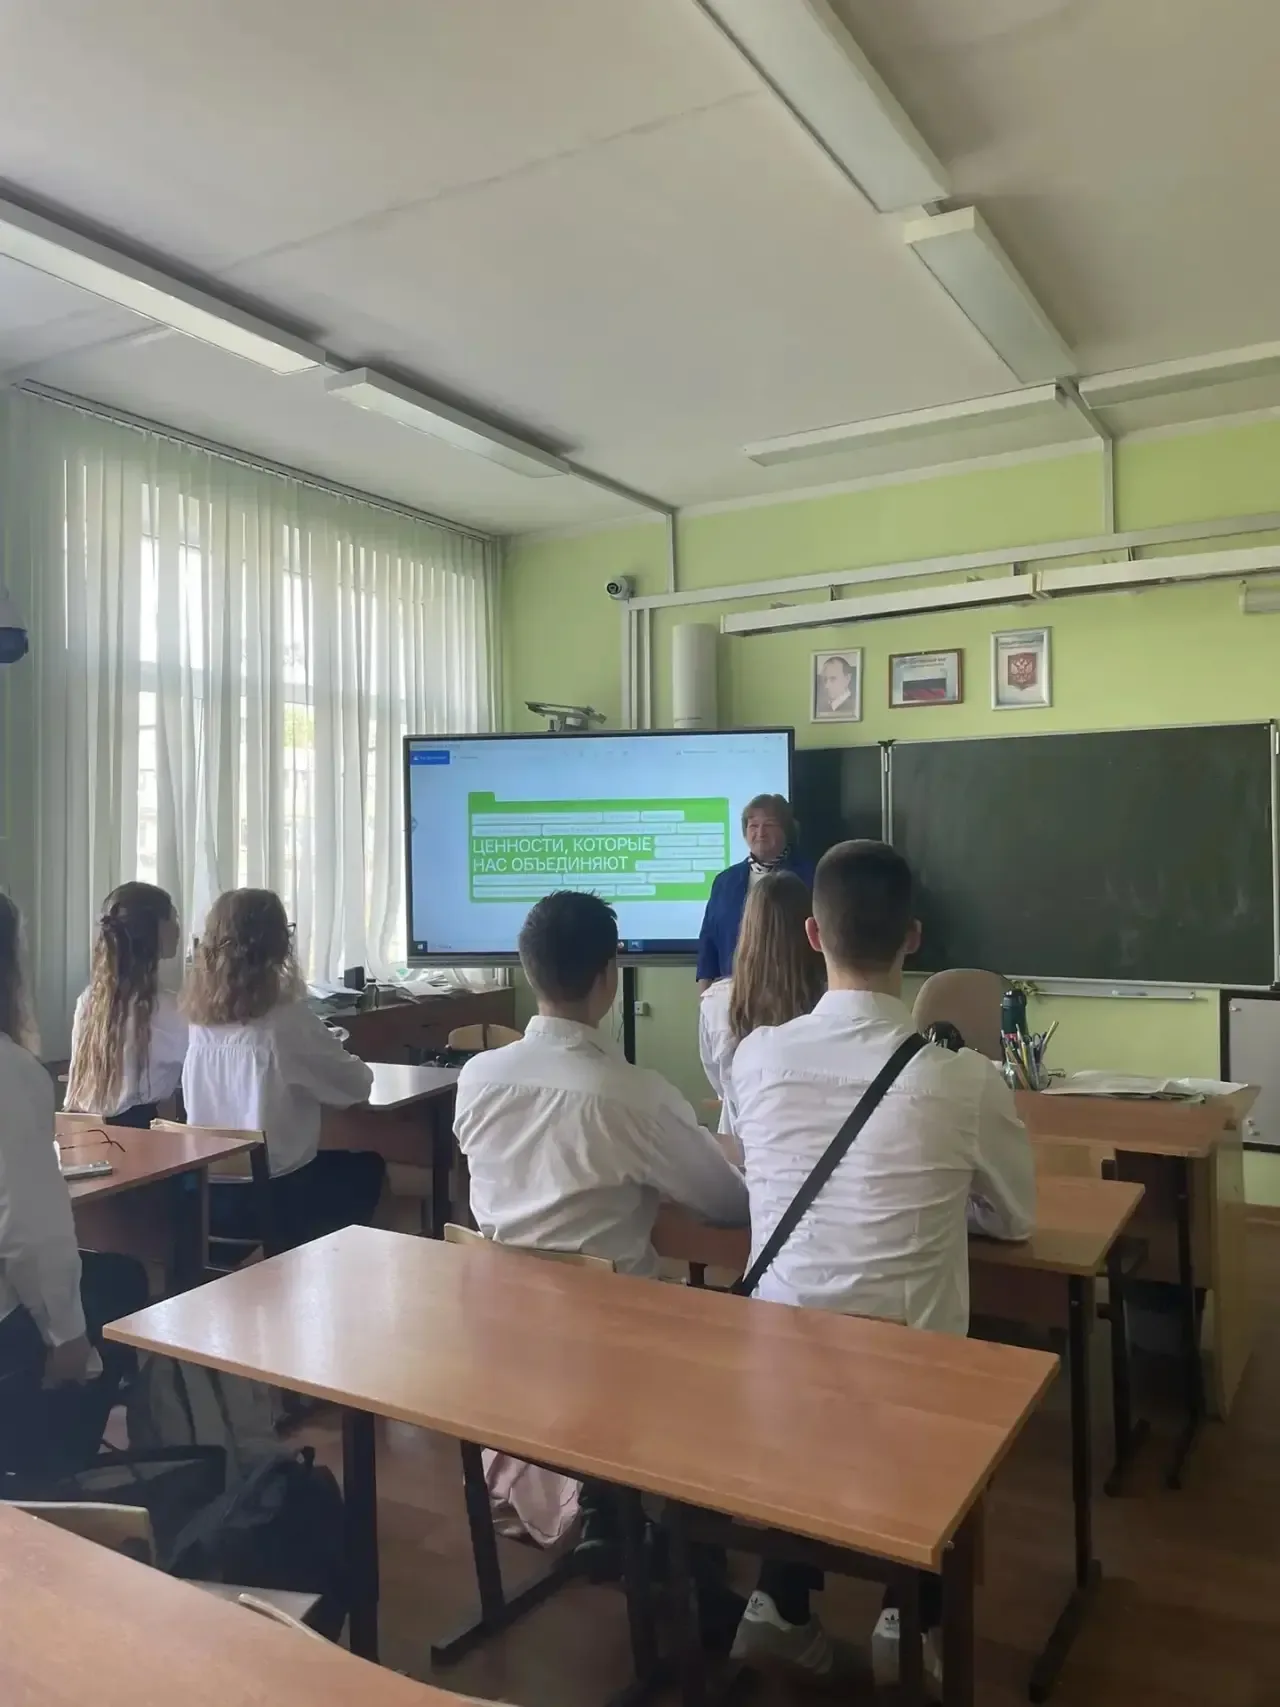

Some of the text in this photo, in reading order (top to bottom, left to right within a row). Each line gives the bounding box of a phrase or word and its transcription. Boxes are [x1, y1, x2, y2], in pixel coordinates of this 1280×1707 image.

[473, 838, 568, 855] ЦЕННОСТИ,
[574, 837, 652, 852] КОТОРЫЕ
[473, 857, 507, 872] НАС
[512, 856, 629, 873] ОБЪЕДИНЯЮТ
